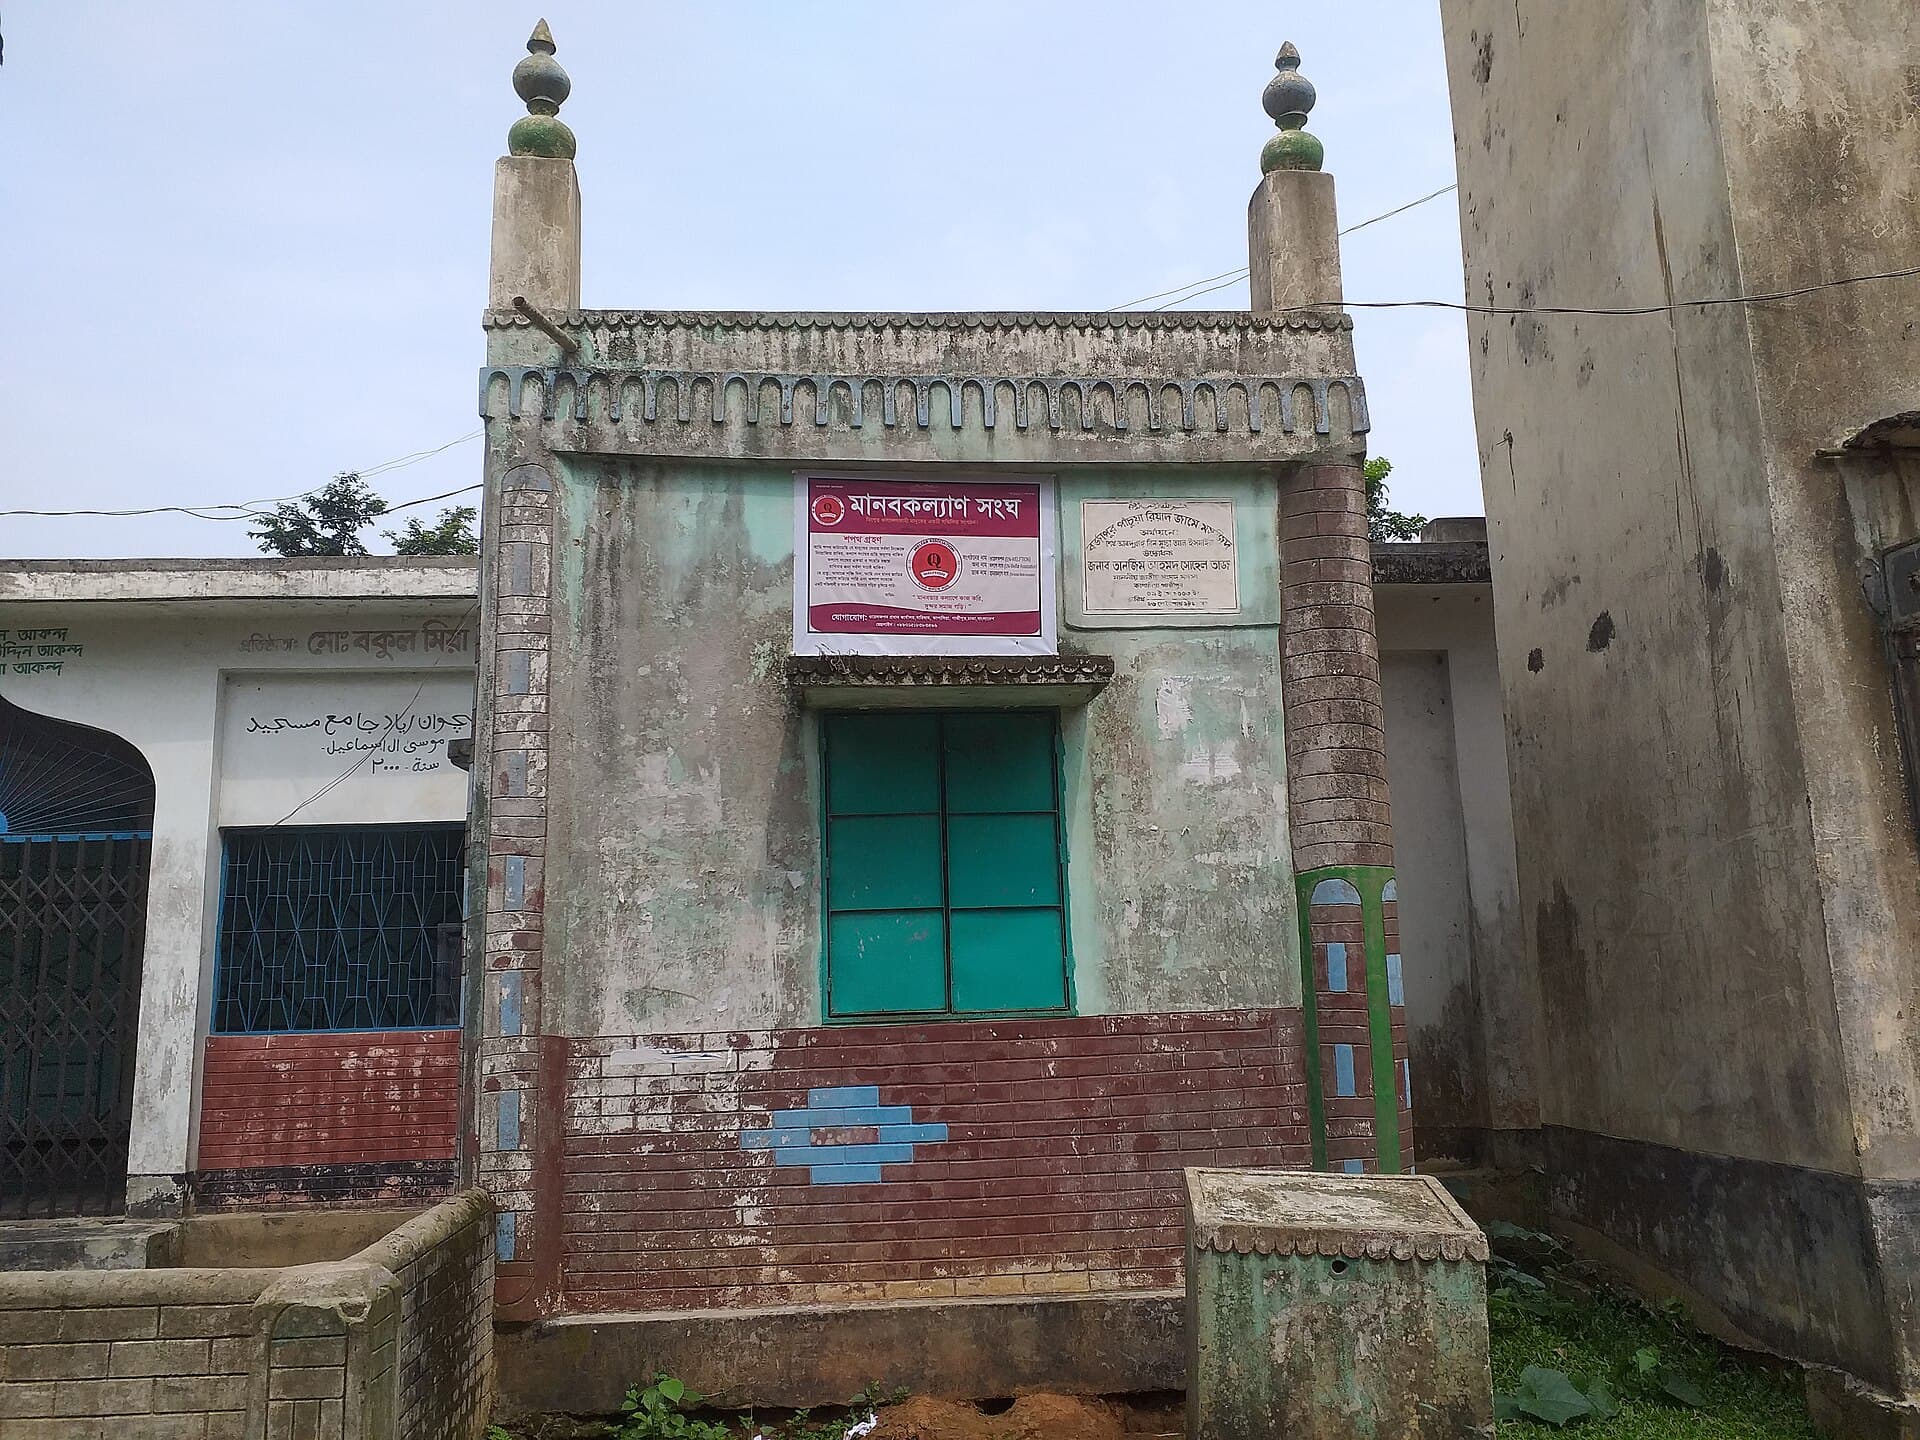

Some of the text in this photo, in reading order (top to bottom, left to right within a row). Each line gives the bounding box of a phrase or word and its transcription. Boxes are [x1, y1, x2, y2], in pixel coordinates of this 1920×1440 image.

[848, 492, 970, 518] মানবকল্যাণ
[975, 498, 1022, 520] সংঘ
[1174, 513, 1200, 529] জামে
[1087, 561, 1111, 572] জনাব
[1112, 558, 1146, 572] তানজিম
[1181, 560, 1208, 572] সোহেল
[1210, 561, 1231, 571] তাজ
[17, 628, 69, 641] আকন্দ
[37, 644, 84, 657] আকন্দ
[351, 629, 416, 661] বকুল
[12, 661, 65, 676] আকন্দ
[372, 757, 440, 775] سنة ٢٠٠٠
